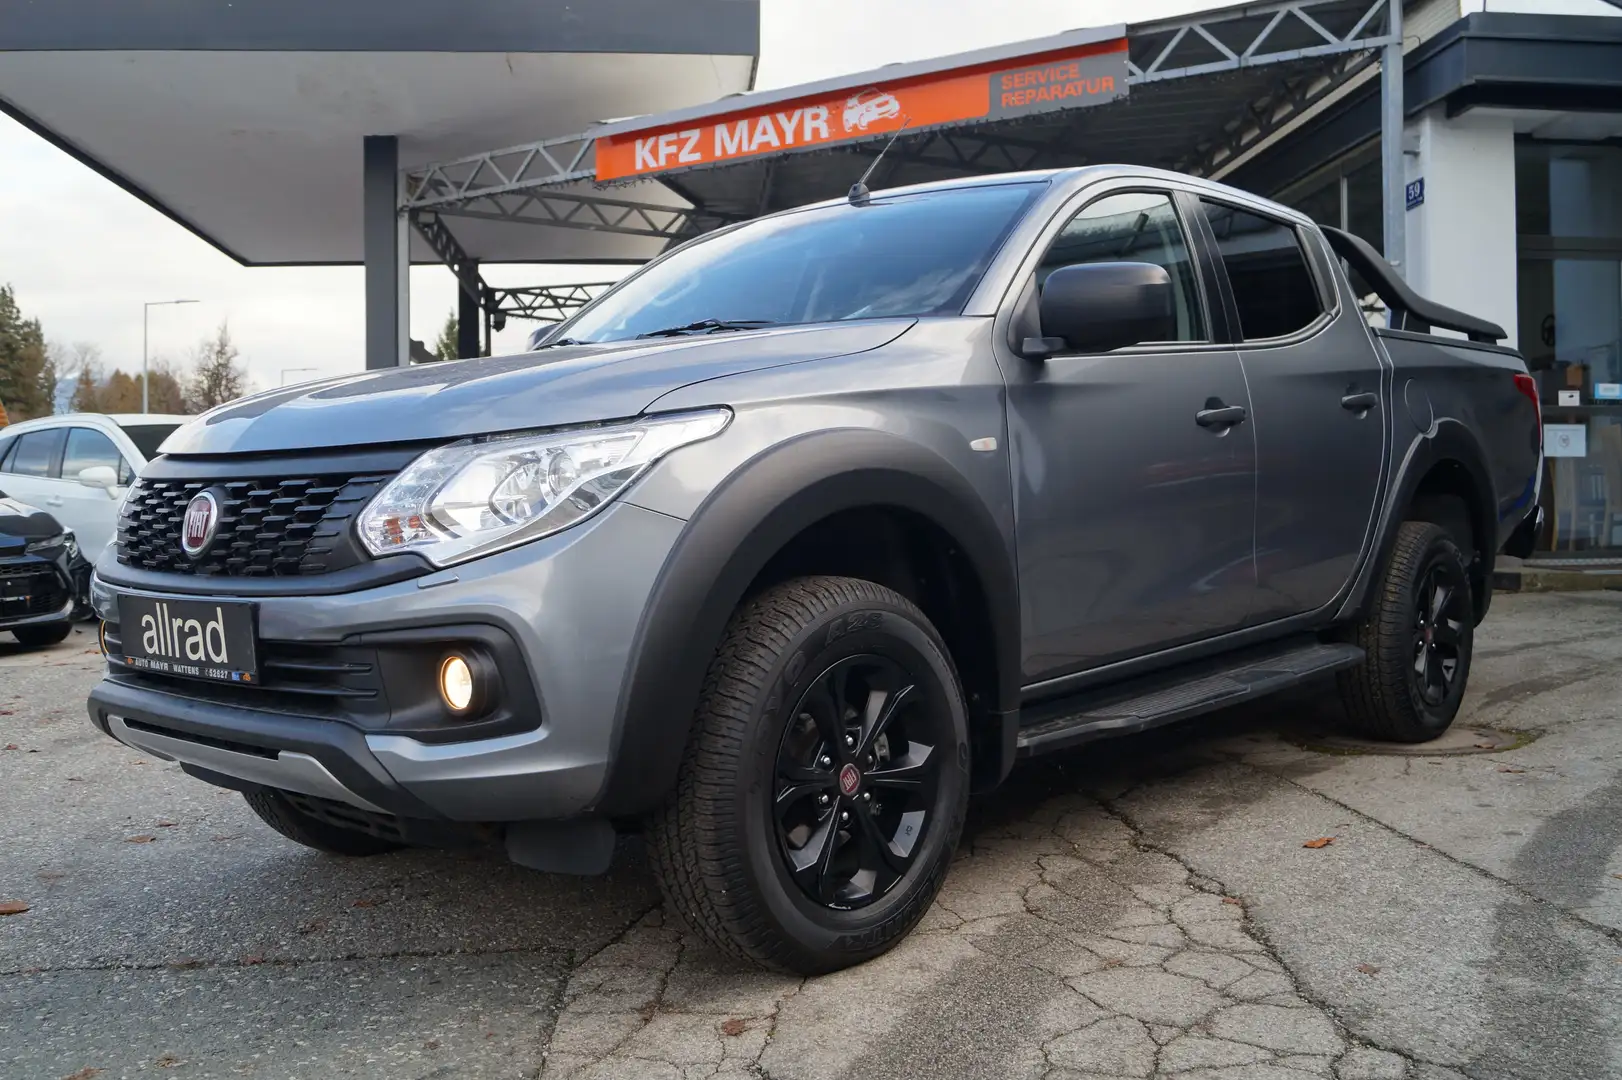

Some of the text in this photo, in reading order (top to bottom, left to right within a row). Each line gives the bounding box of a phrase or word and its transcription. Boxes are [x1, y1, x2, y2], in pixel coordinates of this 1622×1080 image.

[1000, 62, 1082, 91] SERVICE
[1000, 74, 1115, 108] REPARATUR
[633, 105, 830, 172] KFZ MAYR
[1408, 181, 1421, 201] 59
[187, 511, 210, 538] FIAT
[141, 602, 229, 664] allrad
[135, 657, 149, 668] AUTO
[150, 660, 169, 671] MAYR
[173, 663, 200, 676] WATTENS
[843, 769, 857, 791] FIAT
